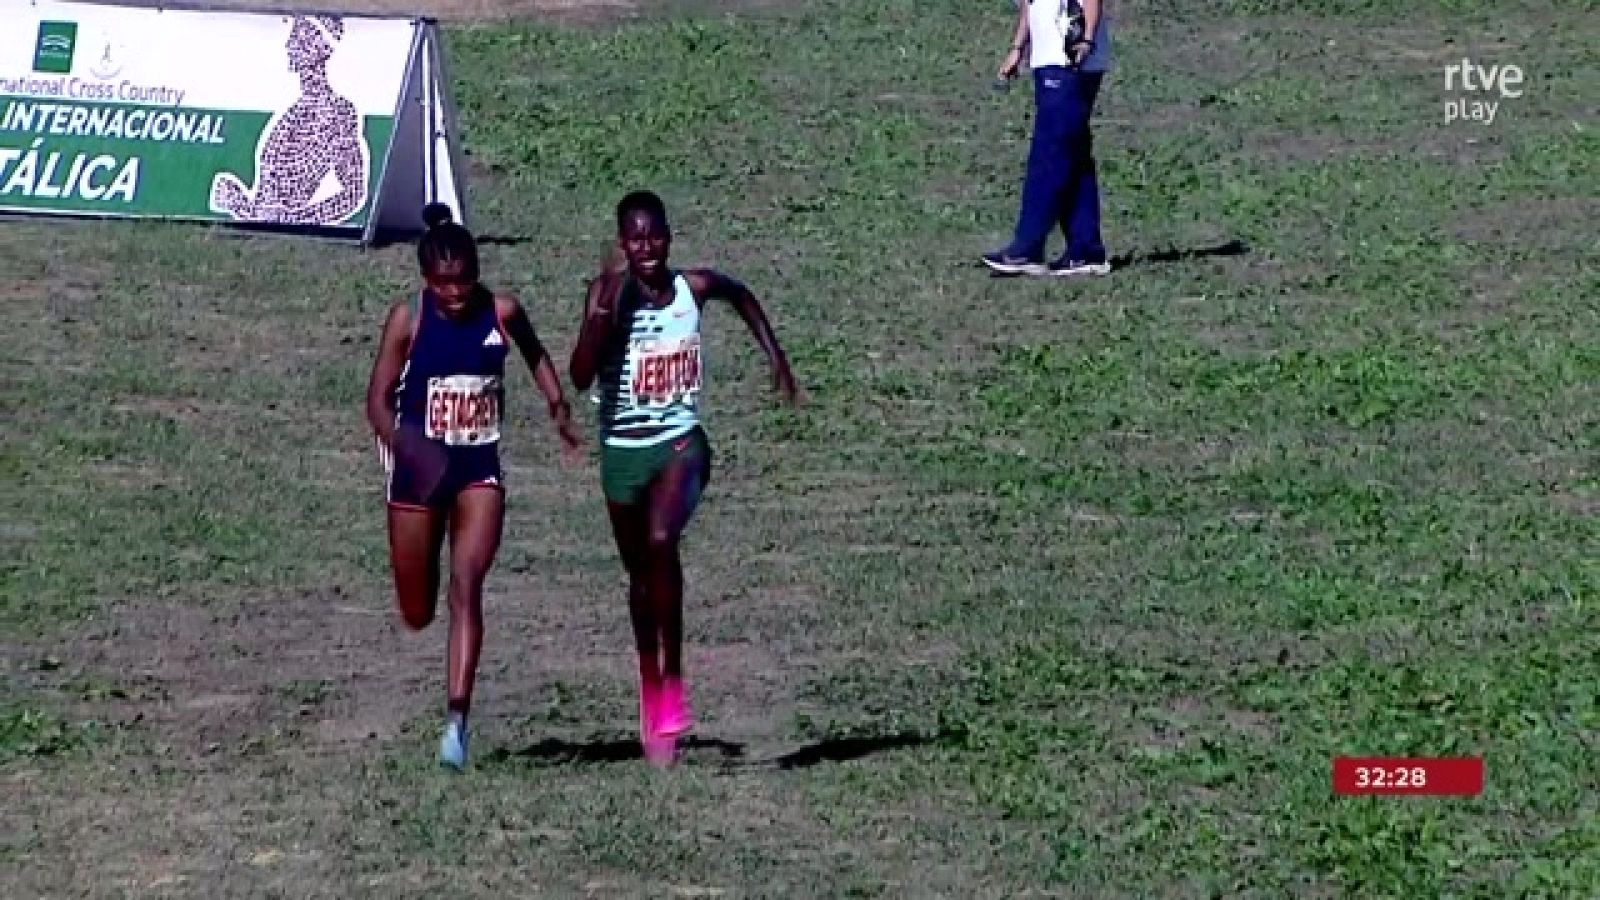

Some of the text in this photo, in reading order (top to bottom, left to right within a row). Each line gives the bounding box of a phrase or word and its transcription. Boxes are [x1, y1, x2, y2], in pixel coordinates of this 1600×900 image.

[69, 77, 113, 98] Cross
[119, 79, 185, 107] Country
[1, 101, 225, 143] INTERNACIONAL
